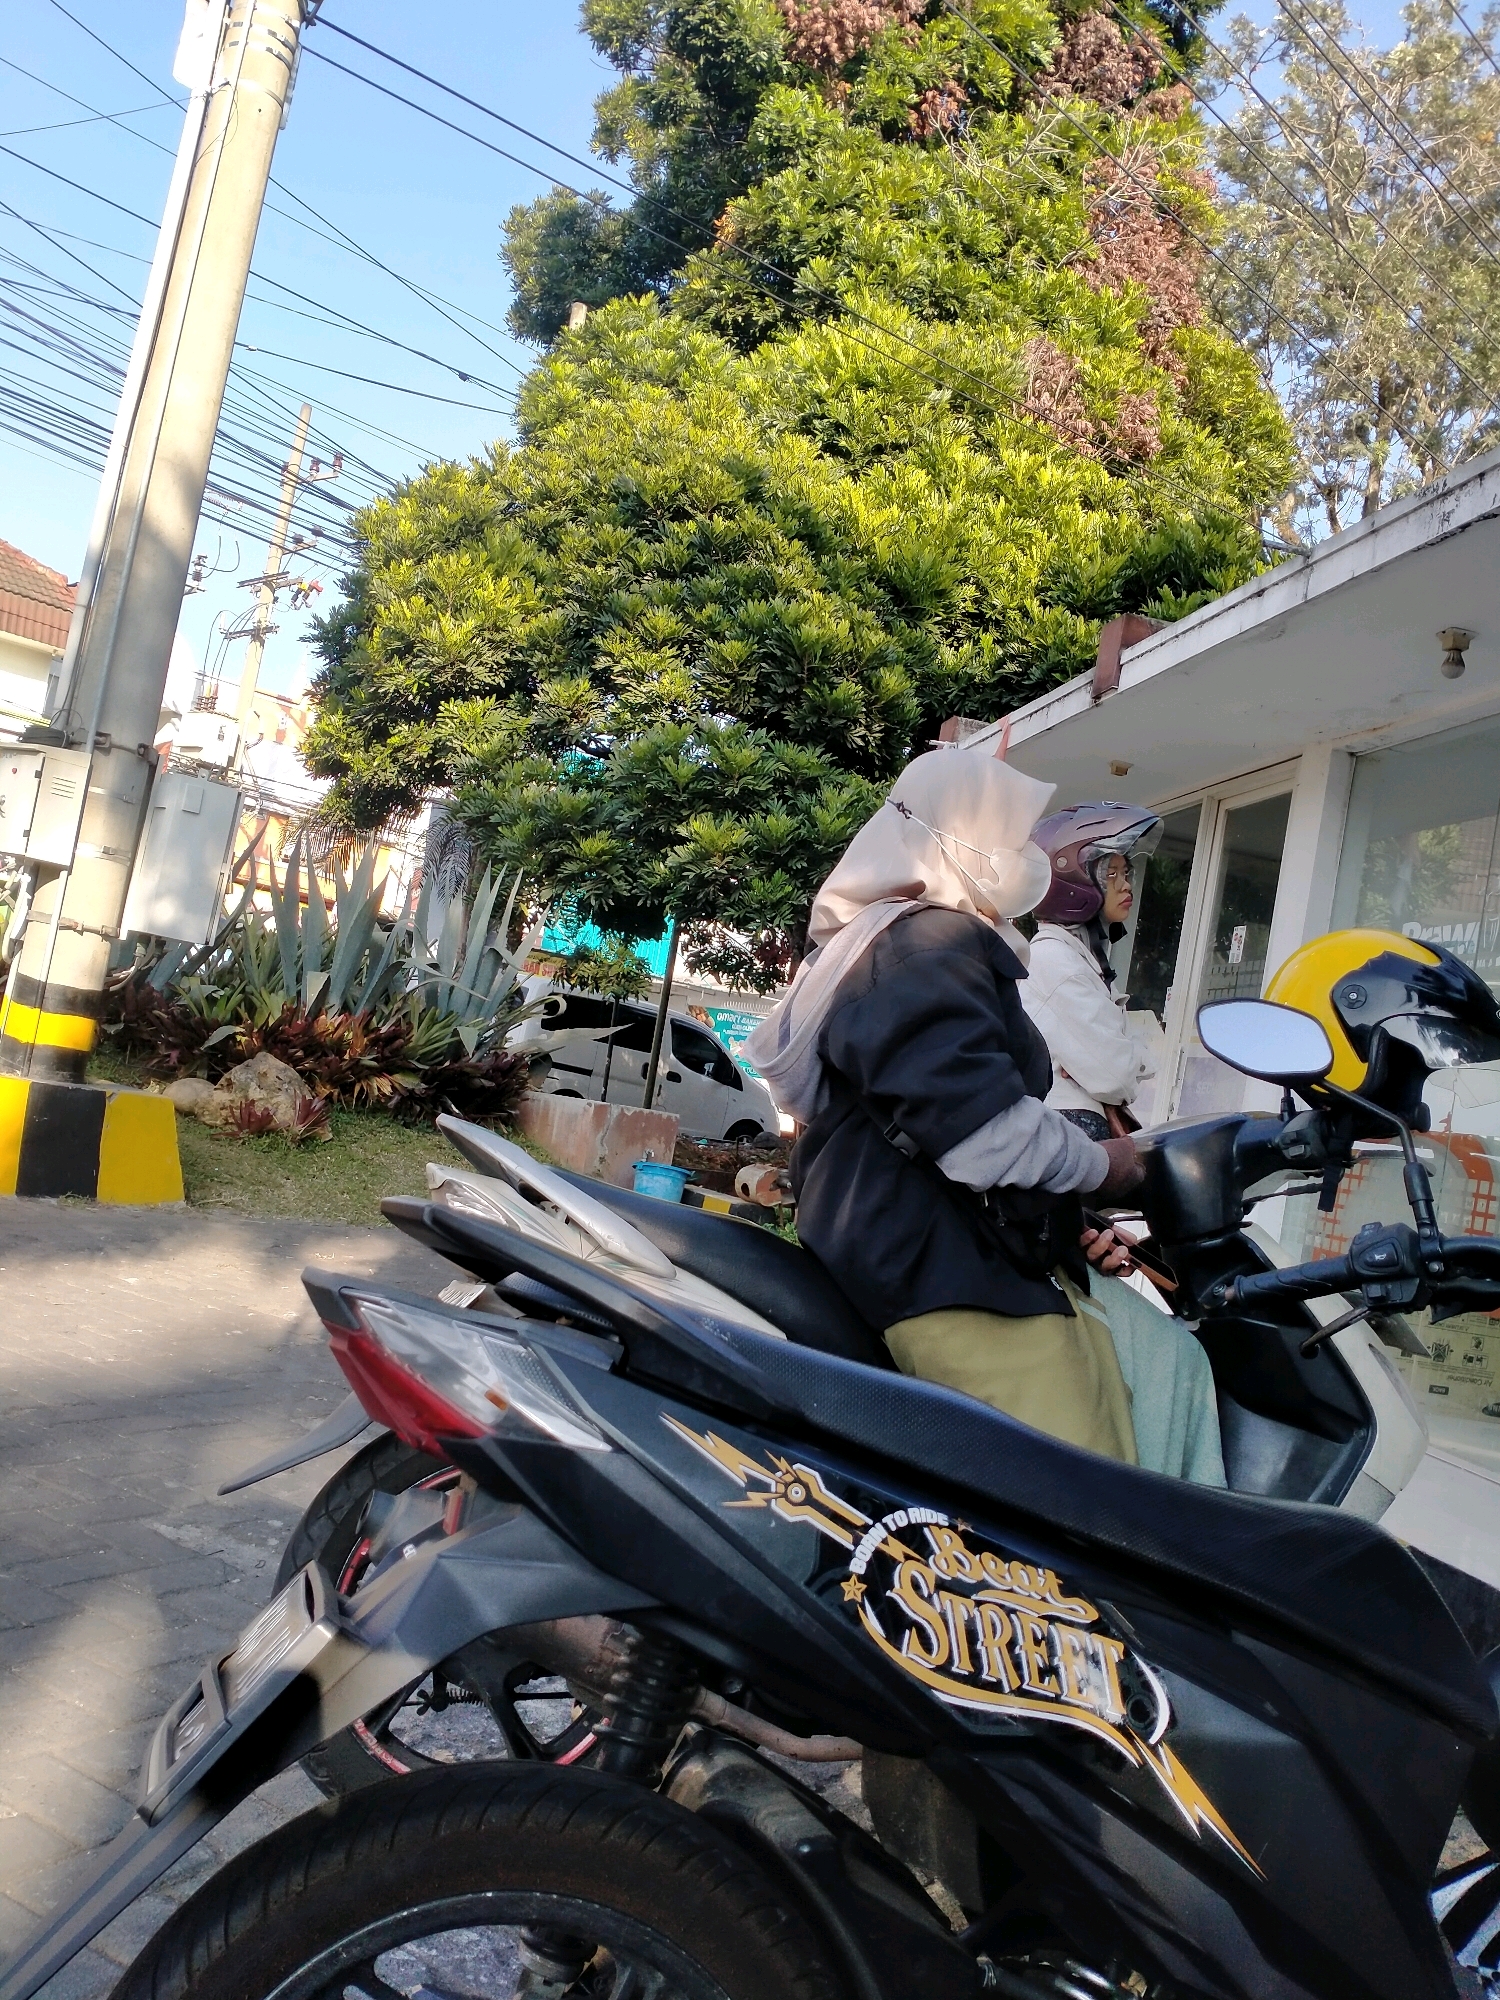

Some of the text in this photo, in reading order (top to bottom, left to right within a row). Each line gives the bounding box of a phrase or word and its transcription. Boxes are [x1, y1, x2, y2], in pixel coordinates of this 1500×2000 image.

[849, 1507, 949, 1575] BORN TO RIDE
[923, 1525, 1098, 1612] Beat
[886, 1559, 1125, 1724] STREET
